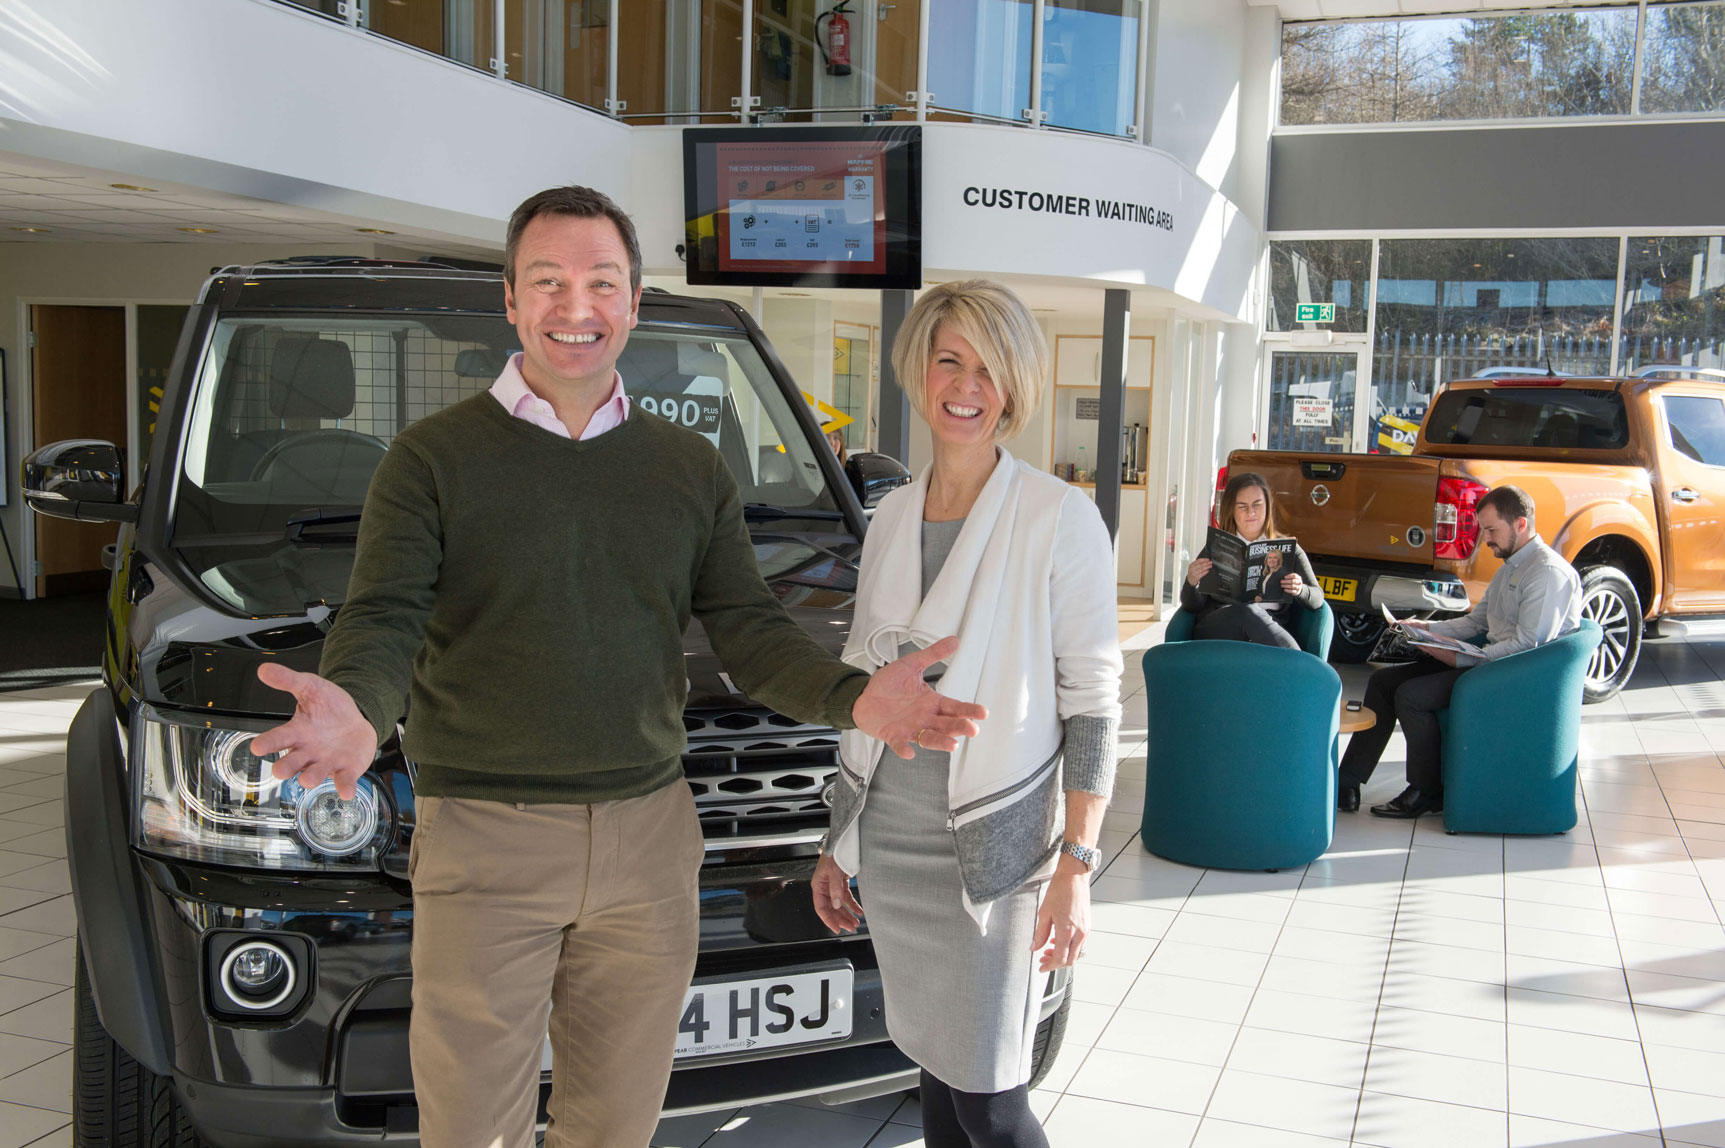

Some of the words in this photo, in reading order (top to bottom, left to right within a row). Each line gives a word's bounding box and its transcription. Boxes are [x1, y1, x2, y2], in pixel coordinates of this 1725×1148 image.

[963, 186, 1090, 217] CUSTOMER
[1095, 199, 1155, 226] WAITING
[1155, 210, 1173, 232] AREA
[628, 395, 700, 427] 990
[703, 406, 719, 415] PLUS
[1249, 545, 1278, 557] BUSINESS
[1279, 544, 1292, 553] LIFE
[1323, 577, 1352, 597] LBF
[678, 992, 710, 1044] 4
[728, 978, 830, 1040] HSJ
[688, 1044, 722, 1053] COMMERCIAL
[722, 1041, 745, 1049] VEHICLES
